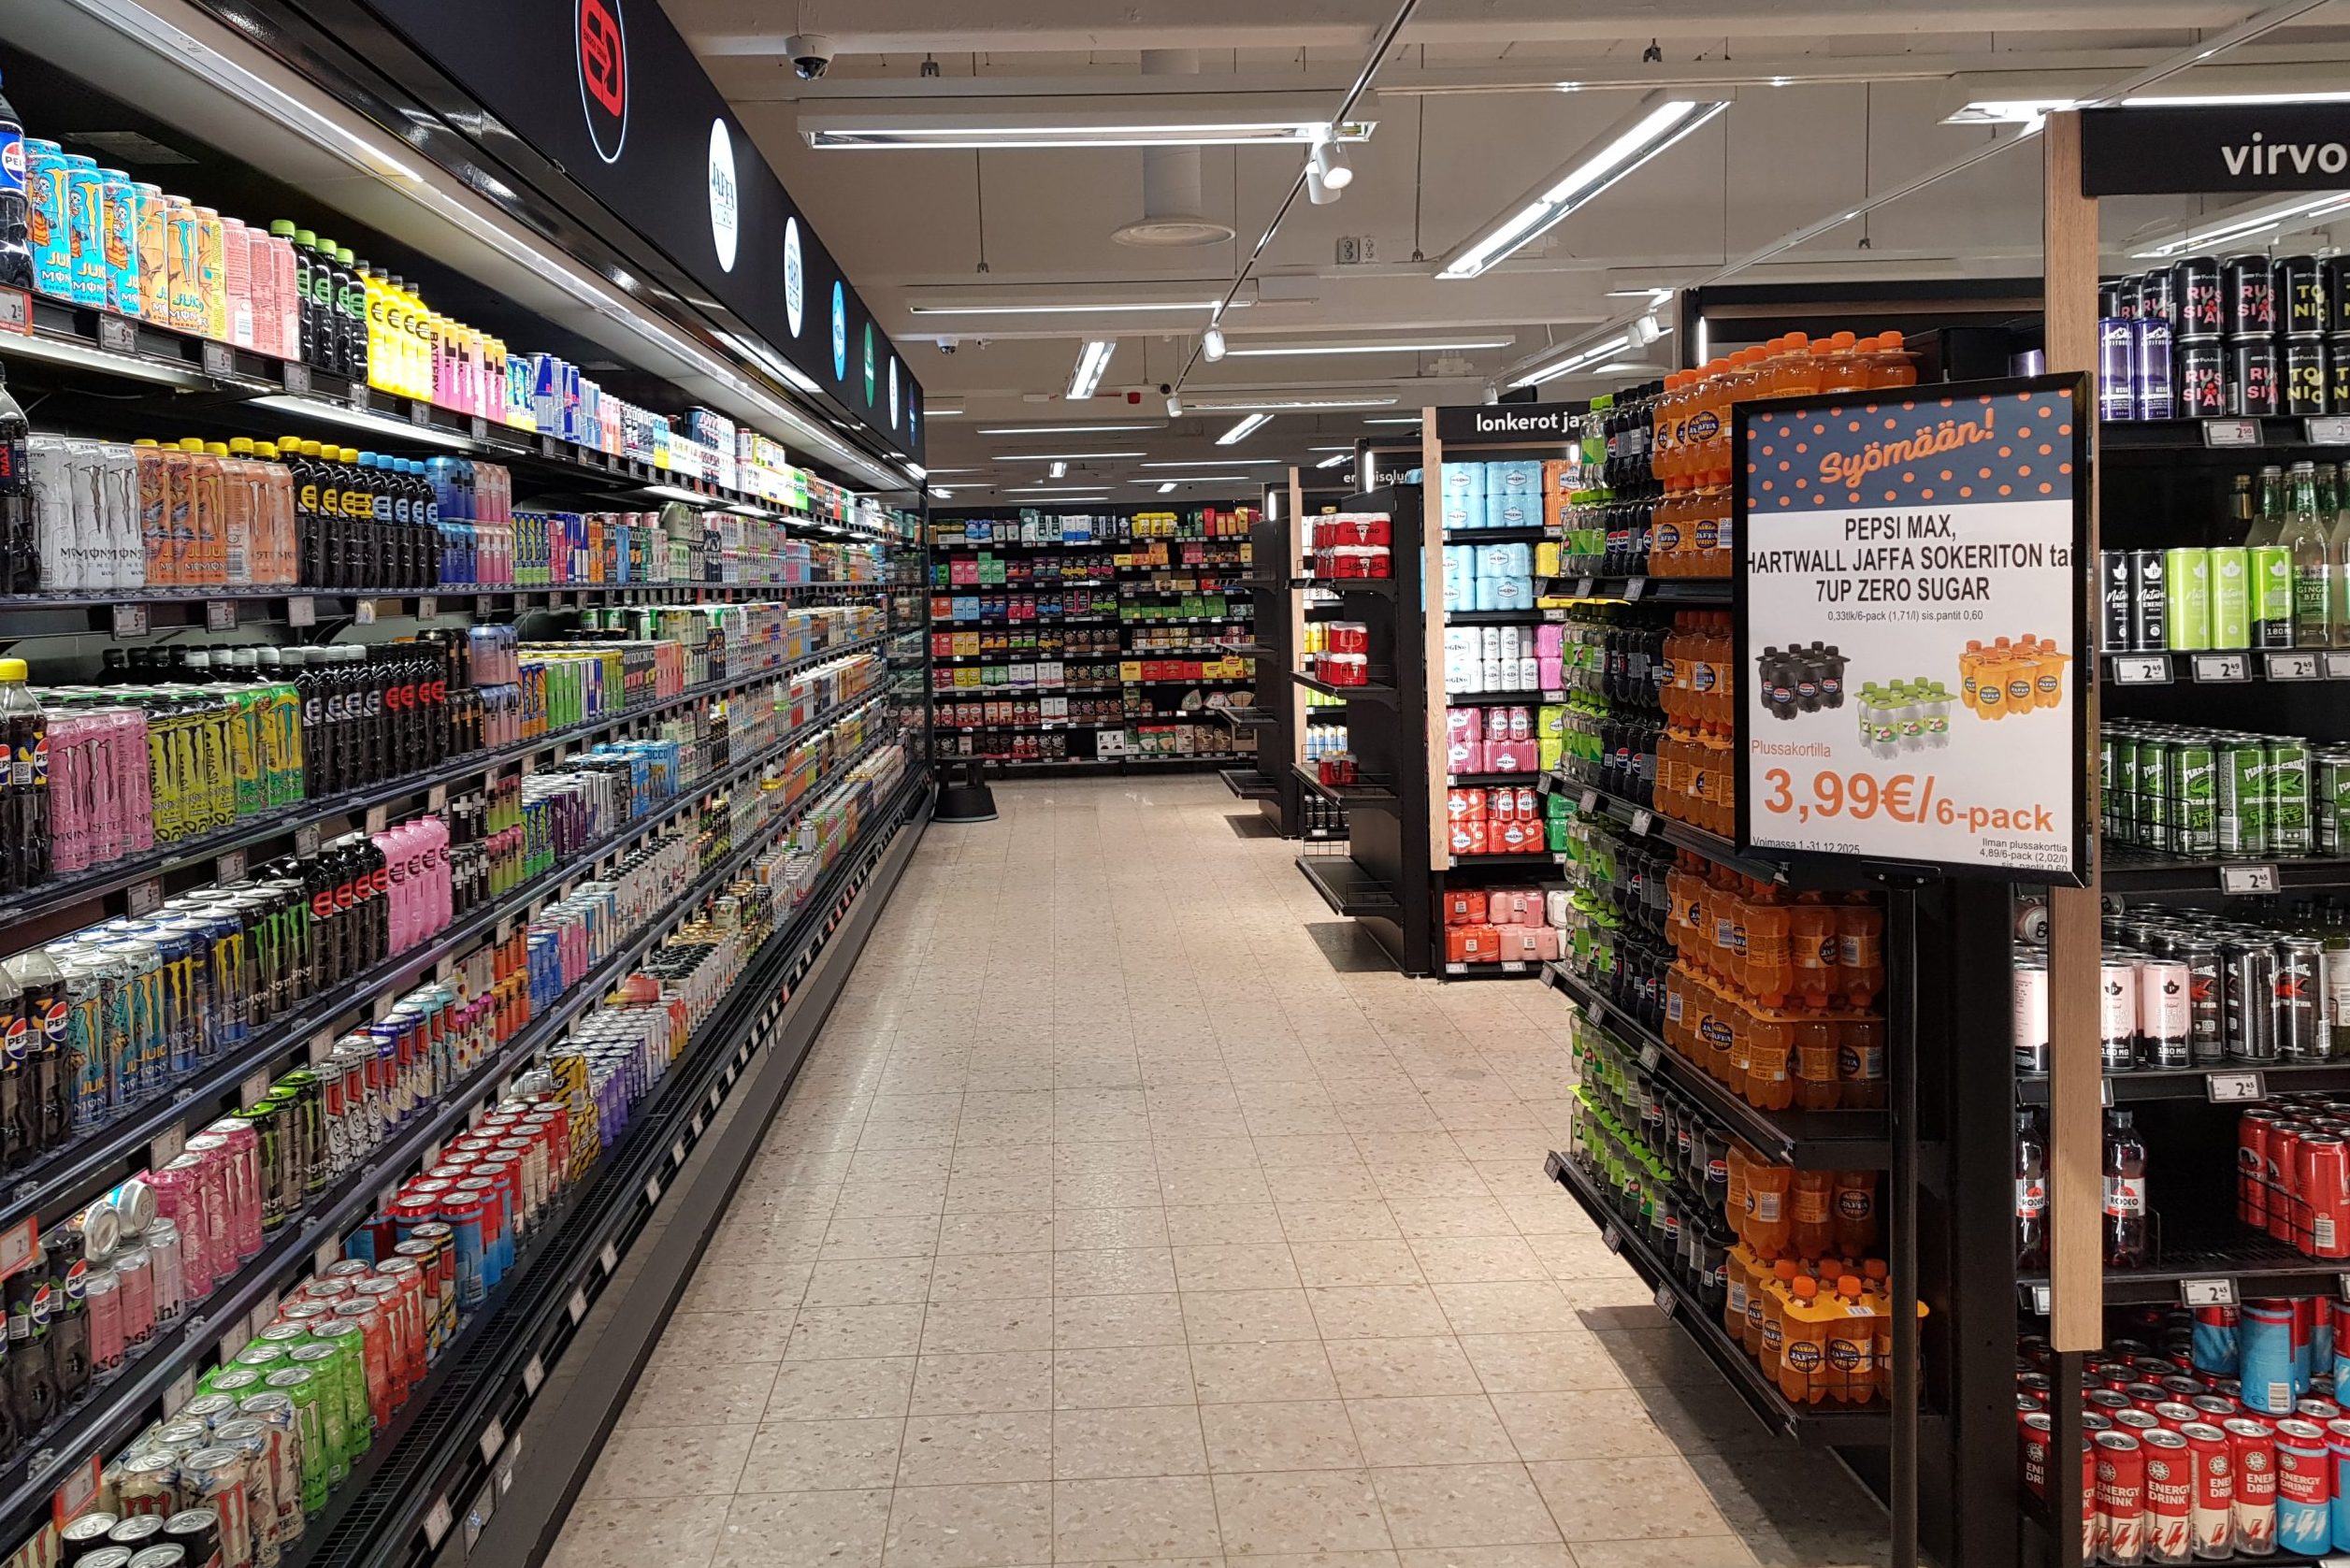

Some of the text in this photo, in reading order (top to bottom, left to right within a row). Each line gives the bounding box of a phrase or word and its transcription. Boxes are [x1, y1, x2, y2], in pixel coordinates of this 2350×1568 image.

[2222, 132, 2347, 175] virvo
[712, 162, 734, 209] JAFFA
[430, 331, 440, 392] BATTERY
[1477, 411, 1580, 433] lonkerot ja
[1820, 408, 1995, 488] Syömään!
[1845, 514, 1956, 541] PEPSI MAX,
[1748, 549, 1847, 573] HARTWALL
[1853, 547, 1915, 571] JAFFA
[1921, 543, 2042, 569] SOKERITON
[1816, 577, 1990, 602] 7UP ZERO SUGAR
[1964, 610, 1983, 622] 0,60
[1752, 740, 1831, 758] Plussakortilla
[2268, 759, 2305, 773] AD-CROC
[1799, 841, 1860, 855] 1-31122025
[1982, 838, 2068, 852] Ilman plussakorttia
[1980, 848, 2032, 860] 4,89/6-pack
[2280, 1470, 2320, 1486] ENERGY
[2097, 1481, 2140, 1496] ENERGY
[2148, 1481, 2190, 1495] ENERGY
[2280, 1479, 2314, 1493] DRINK
[2097, 1491, 2133, 1506] DRINK
[2148, 1491, 2185, 1504] DRINK
